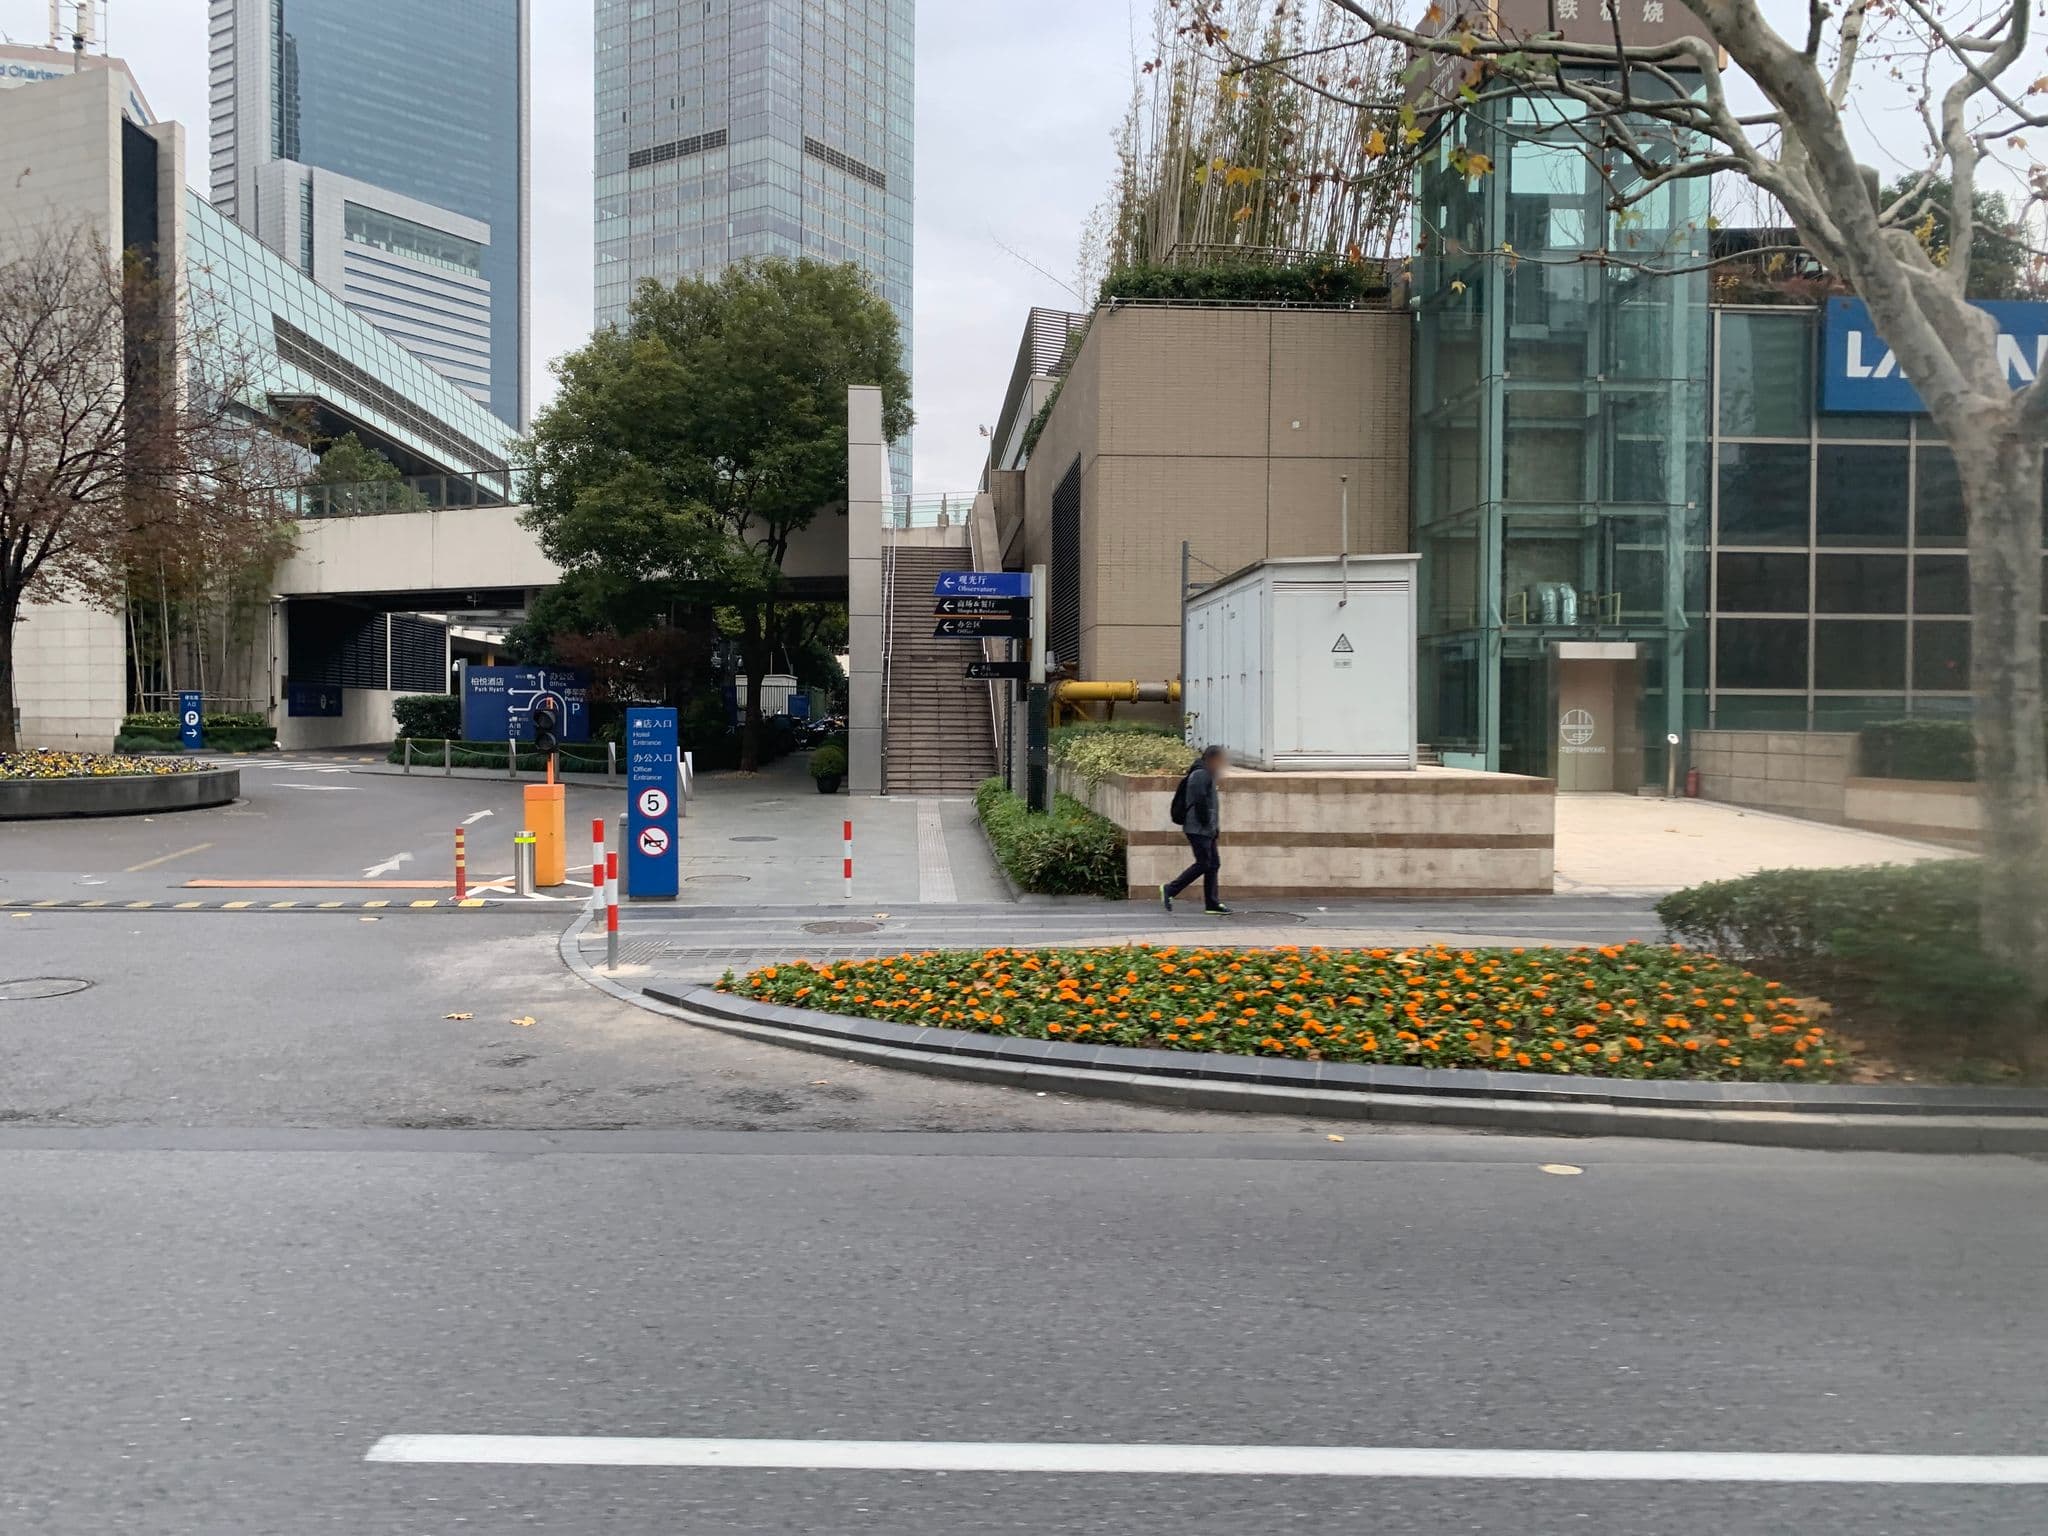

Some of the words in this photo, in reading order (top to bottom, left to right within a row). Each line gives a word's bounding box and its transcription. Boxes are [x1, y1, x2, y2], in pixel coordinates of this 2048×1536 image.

[959, 575, 987, 585] 观光厅
[957, 585, 998, 593] Observatory
[471, 677, 505, 686] 柏悦酒店
[633, 753, 673, 763] 办公入口
[648, 794, 659, 811] 5
